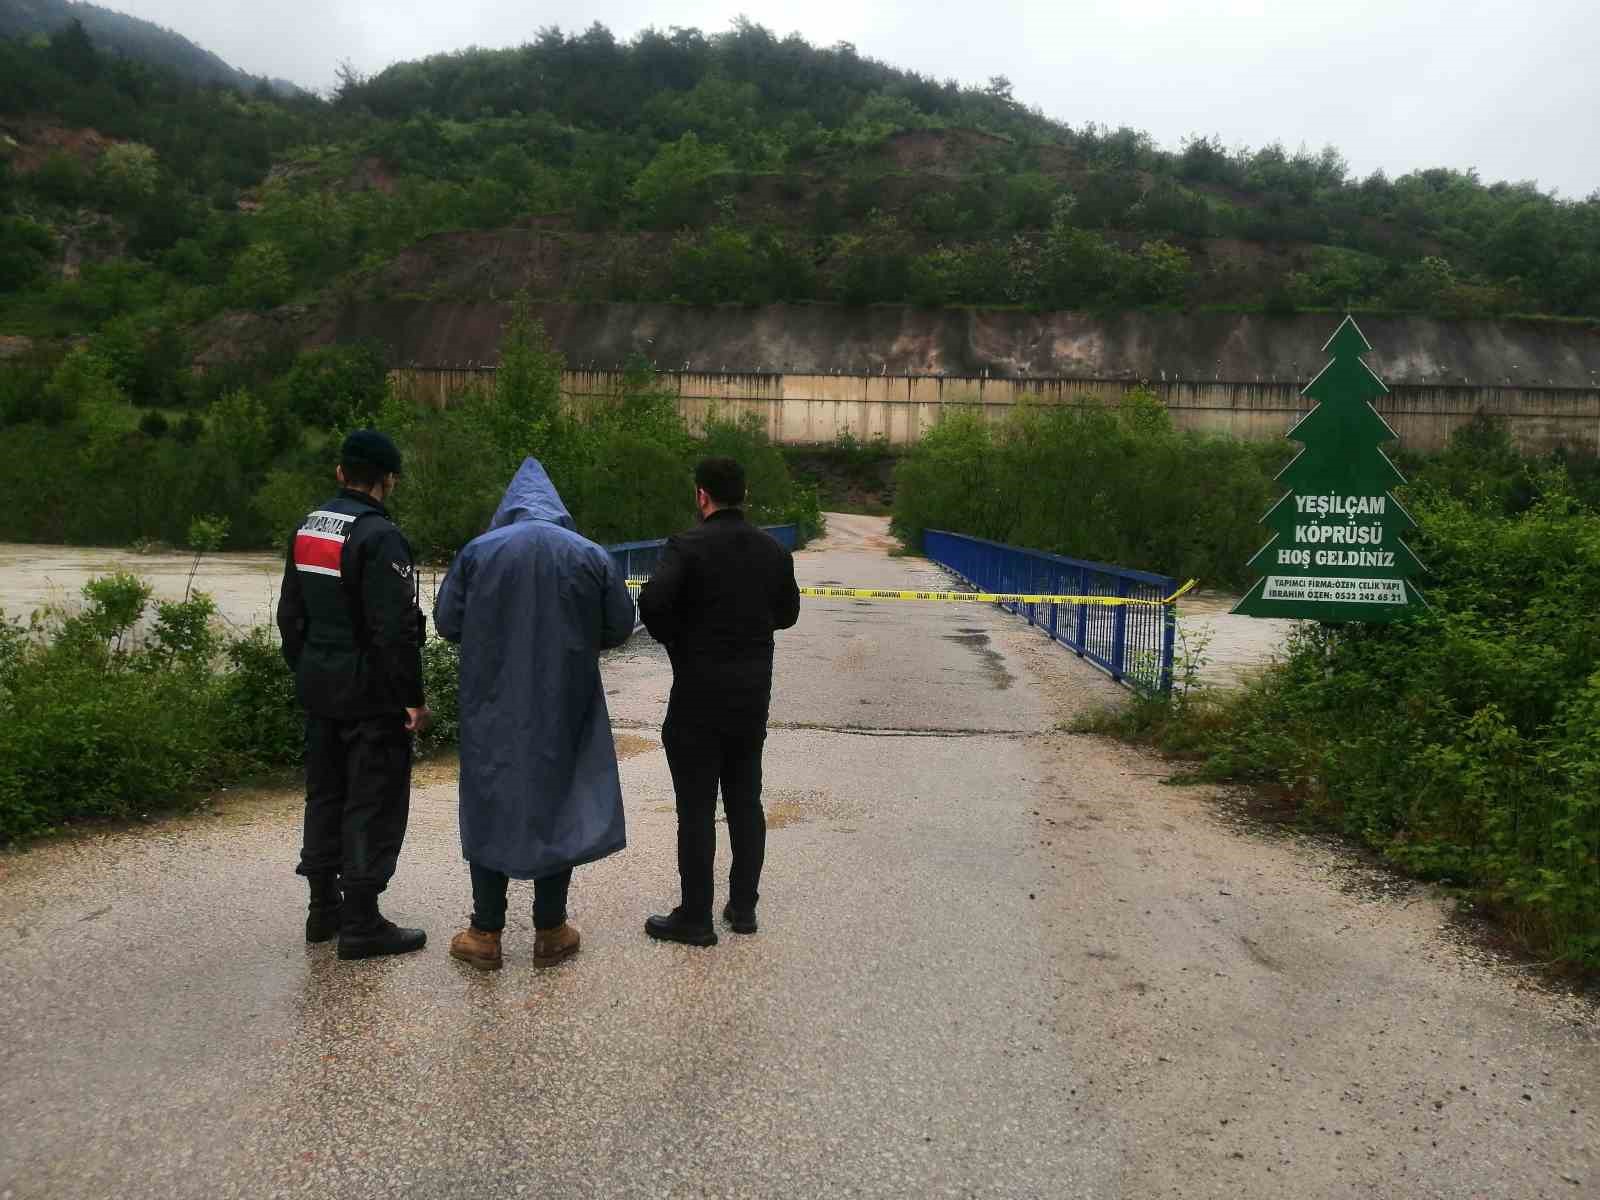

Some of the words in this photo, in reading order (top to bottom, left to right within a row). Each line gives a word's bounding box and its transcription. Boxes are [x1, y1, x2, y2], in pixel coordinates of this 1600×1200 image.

[1295, 490, 1385, 518] YEŞİLÇAM
[1295, 520, 1383, 544] KÖPRÜSÜ
[1277, 549, 1310, 568] HOŞ
[1315, 548, 1395, 567] GELDİNİZ
